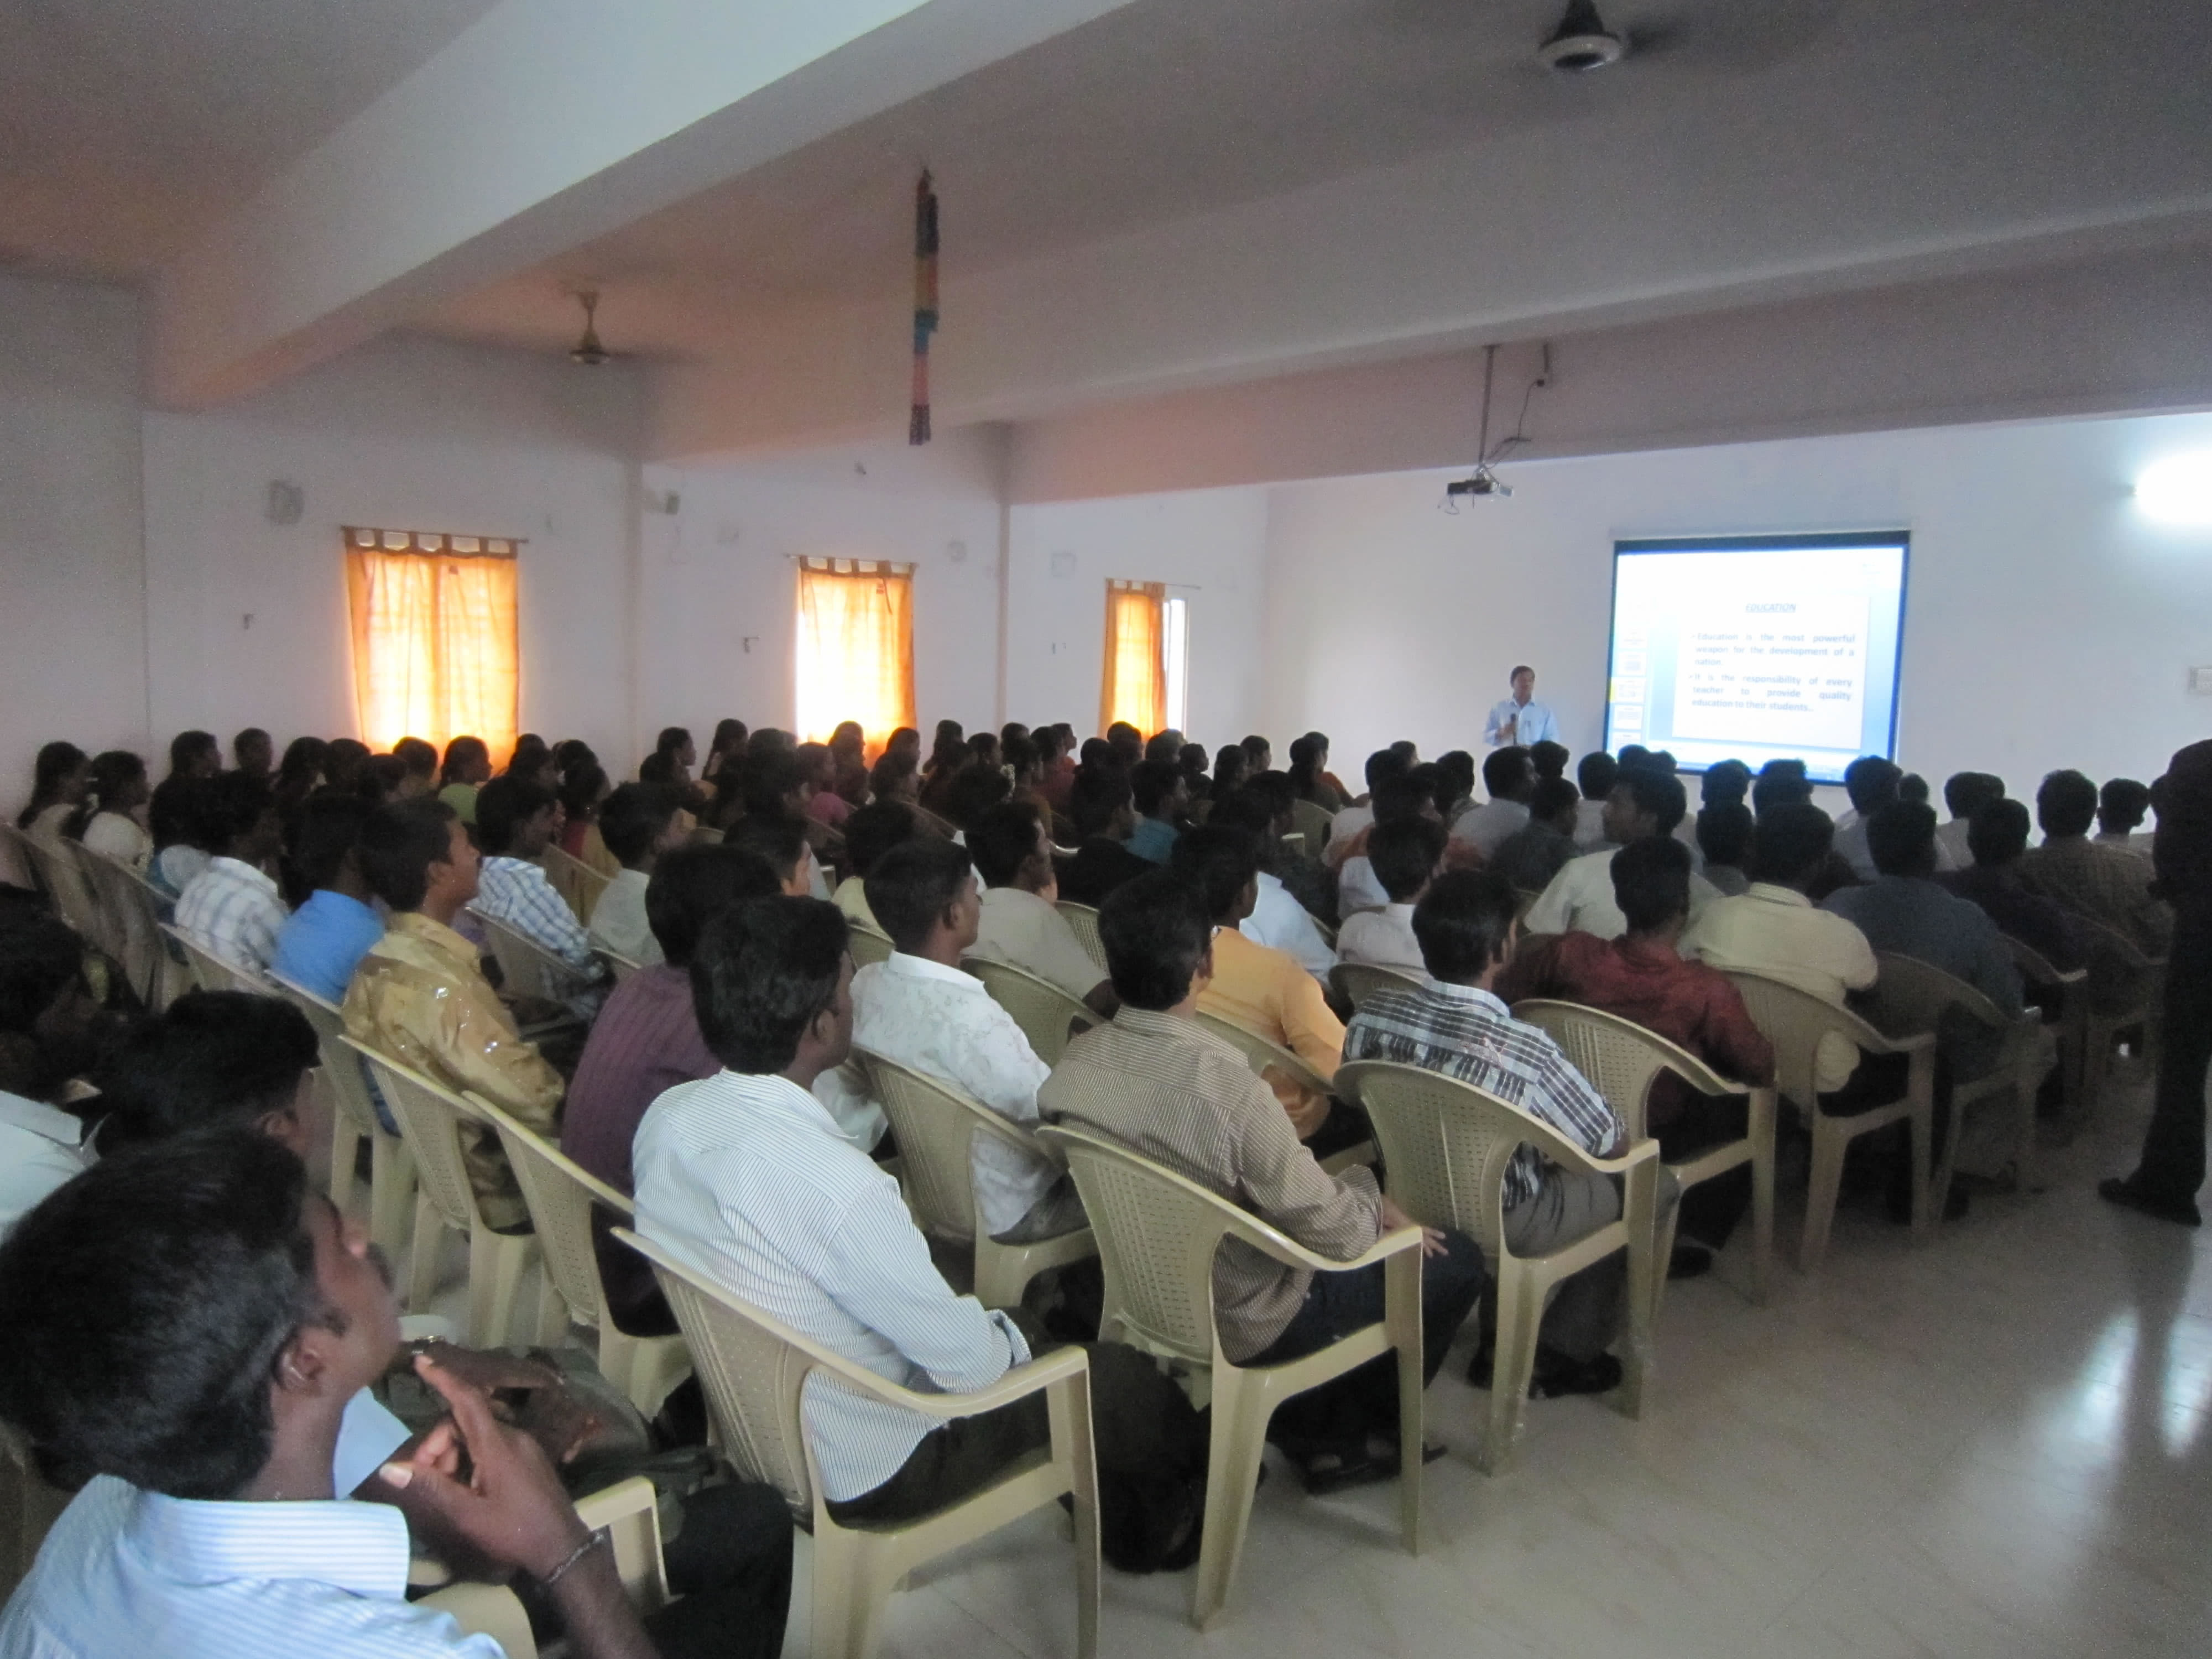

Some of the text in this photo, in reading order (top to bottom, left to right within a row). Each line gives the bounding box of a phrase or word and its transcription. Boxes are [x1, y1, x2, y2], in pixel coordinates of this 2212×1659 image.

[1746, 603, 1796, 613] EDUCATION
[1813, 633, 1856, 643] powerful
[1769, 647, 1828, 657] development
[1833, 648, 1845, 656] of
[1743, 675, 1801, 686] responsibility
[1809, 676, 1819, 685] of
[1825, 679, 1853, 687] every
[1693, 686, 1724, 694] teacher
[1766, 689, 1801, 698] provide
[1818, 691, 1852, 702] quality
[1692, 699, 1734, 708] education
[1734, 700, 1744, 708] to
[1746, 700, 1766, 709] their
